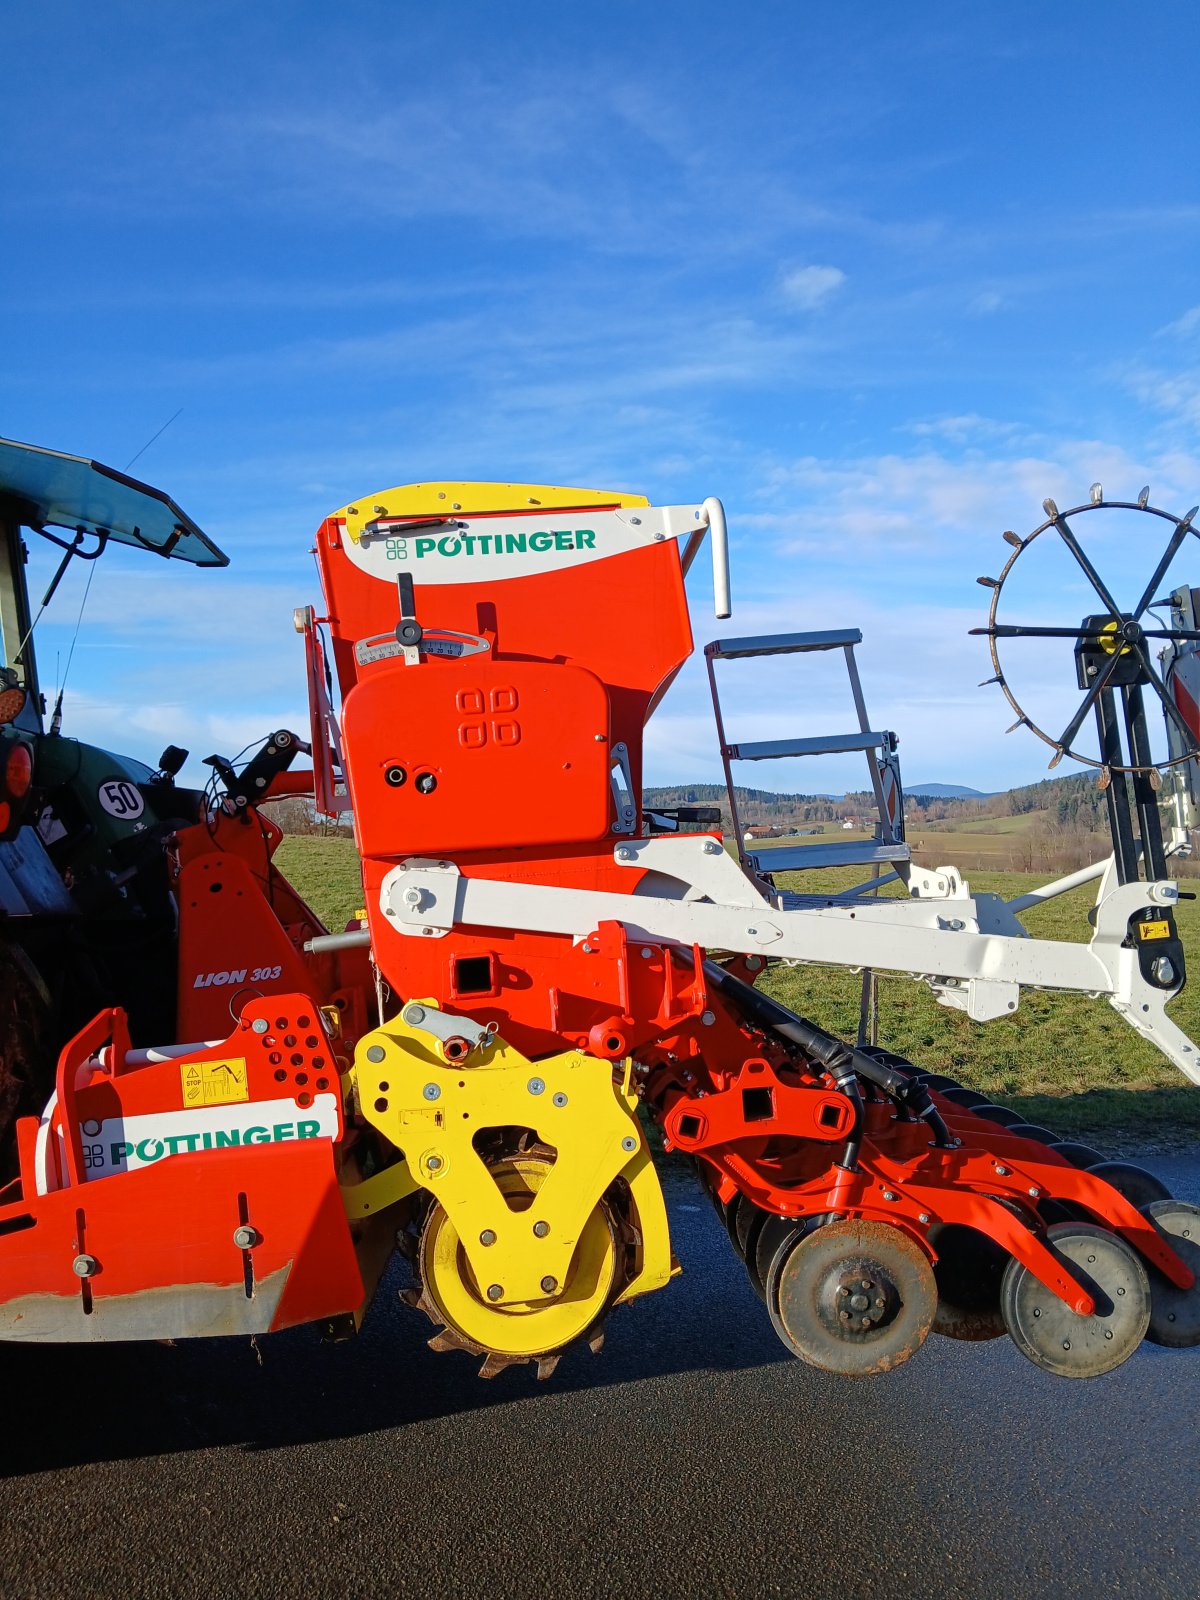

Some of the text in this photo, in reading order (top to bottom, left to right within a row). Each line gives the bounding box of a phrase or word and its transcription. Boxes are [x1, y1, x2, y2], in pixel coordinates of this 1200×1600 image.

[104, 782, 140, 815] 50
[193, 965, 282, 988] LION 303
